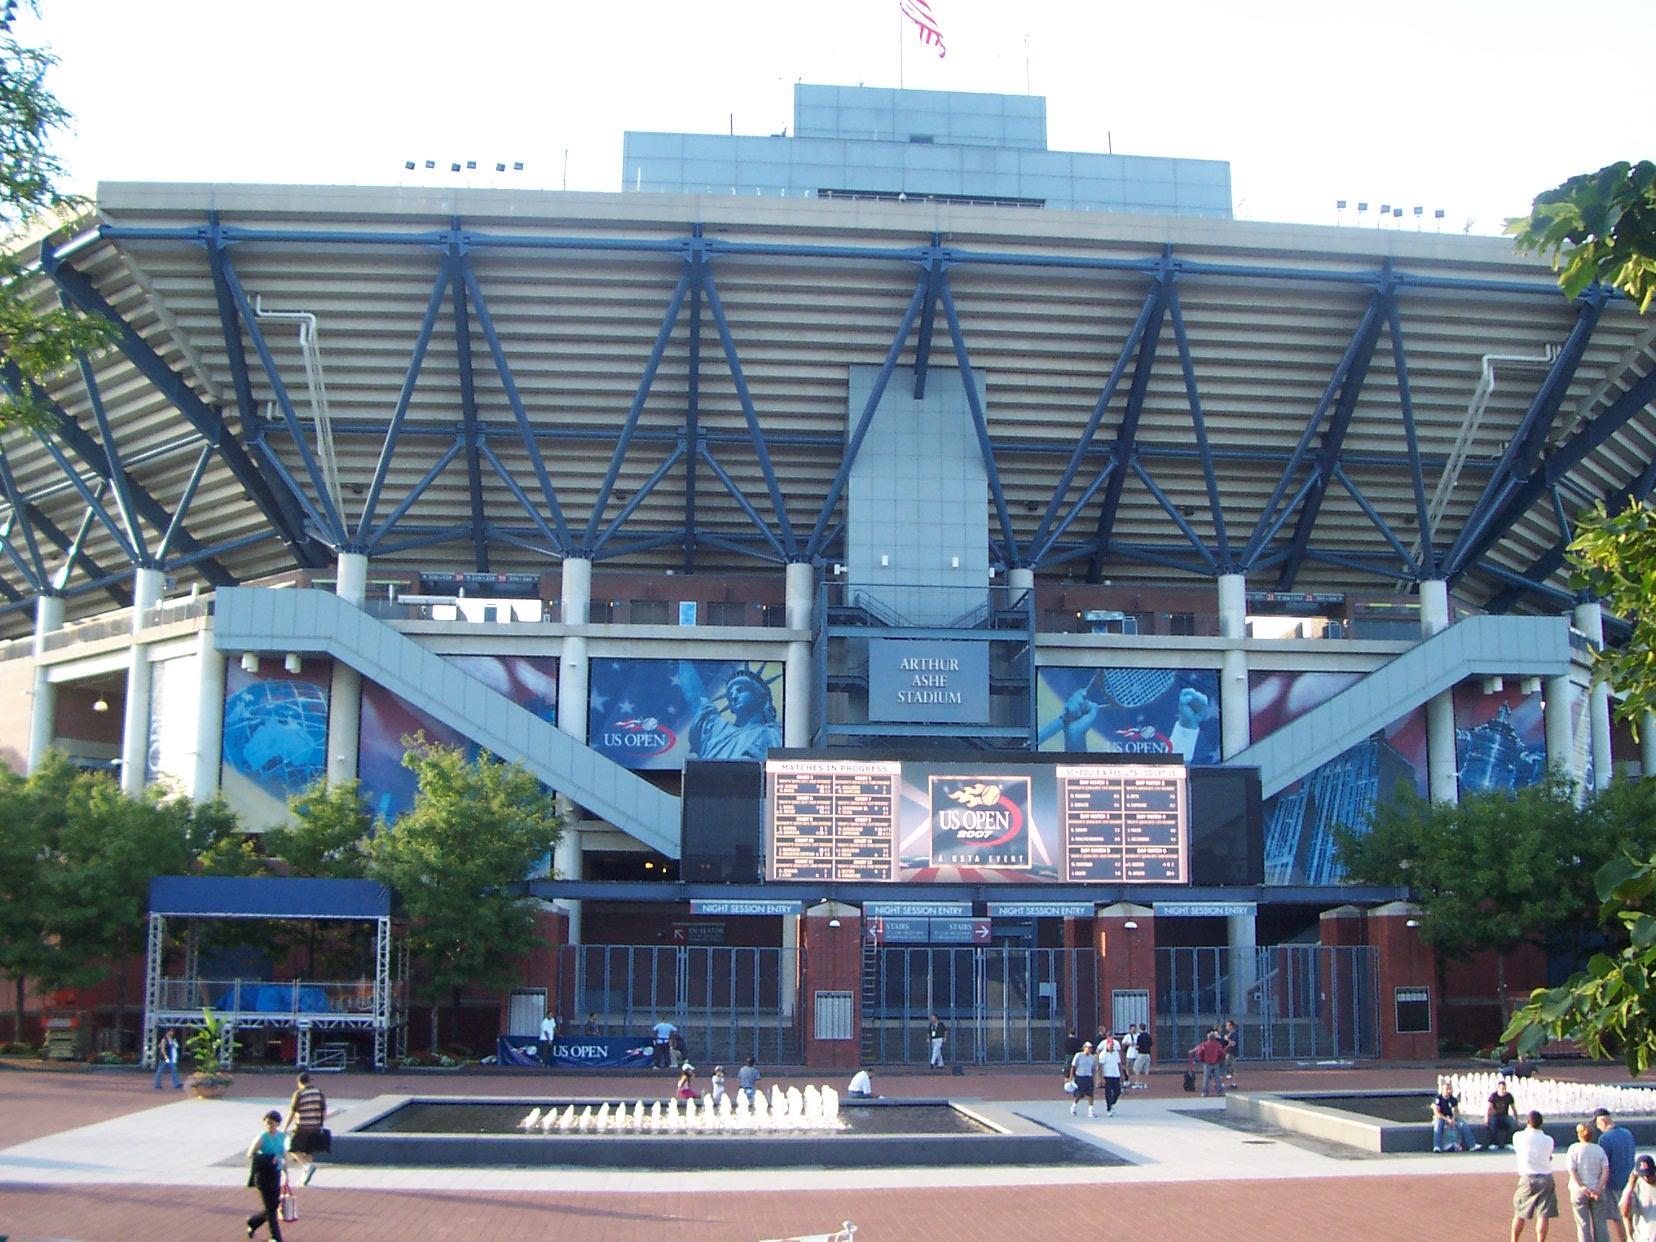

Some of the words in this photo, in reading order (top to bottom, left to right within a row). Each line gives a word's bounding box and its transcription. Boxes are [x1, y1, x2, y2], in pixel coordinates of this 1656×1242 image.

[900, 658, 960, 671] ARTHUR
[912, 674, 948, 687] ASHE
[897, 690, 962, 704] STADIUM
[604, 733, 622, 747] US
[625, 733, 667, 747] OPEN
[1125, 742, 1164, 753] OPEN
[939, 810, 960, 830] US
[962, 810, 1010, 830] OPEN
[956, 830, 994, 838] 2007
[702, 904, 728, 914] NIGHT
[730, 904, 765, 914] SESSION
[766, 904, 792, 914] ENTRY
[875, 906, 902, 916] NIGHT
[904, 906, 936, 916] SESSION
[938, 906, 963, 916] ENTRY
[999, 906, 1023, 916] NIGHT
[1025, 906, 1055, 916] SESSION
[1056, 906, 1085, 915] ENTRY
[1164, 906, 1188, 915] NIGHT
[1190, 906, 1220, 915] SESSION
[1222, 906, 1248, 915] ENTRY
[553, 1045, 568, 1058] US
[570, 1045, 608, 1058] OPEN
